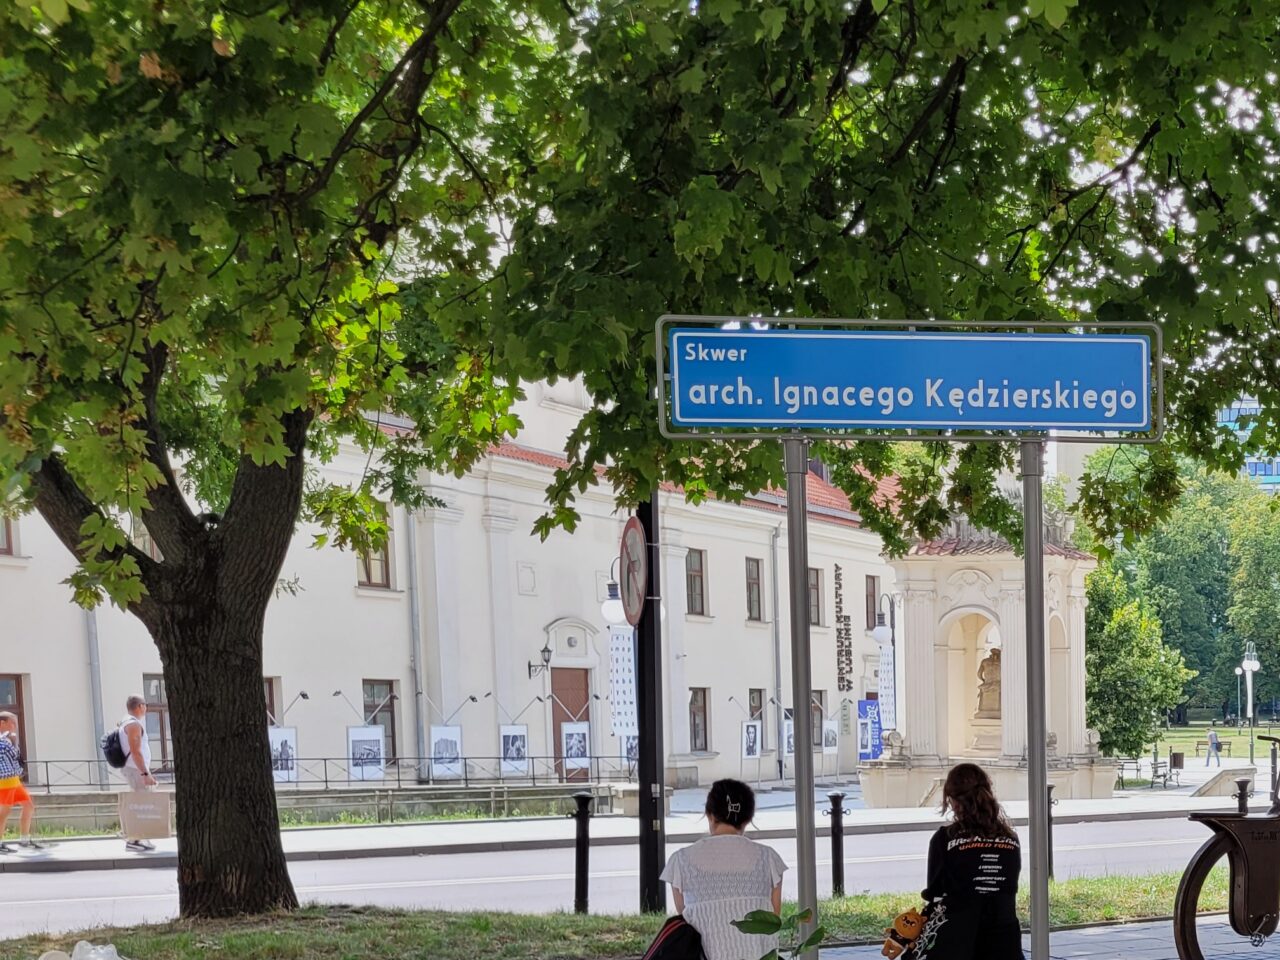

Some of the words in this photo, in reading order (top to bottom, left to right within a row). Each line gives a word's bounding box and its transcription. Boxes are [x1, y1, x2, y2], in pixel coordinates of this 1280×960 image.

[684, 343, 747, 362] Skwer
[689, 377, 763, 405] arch.
[774, 377, 914, 416] Ignacego
[926, 378, 1137, 418] Kędzierskiego
[834, 563, 844, 624] KULTURY
[836, 628, 846, 692] CENTRUM
[843, 615, 853, 675] LUBLINIE
